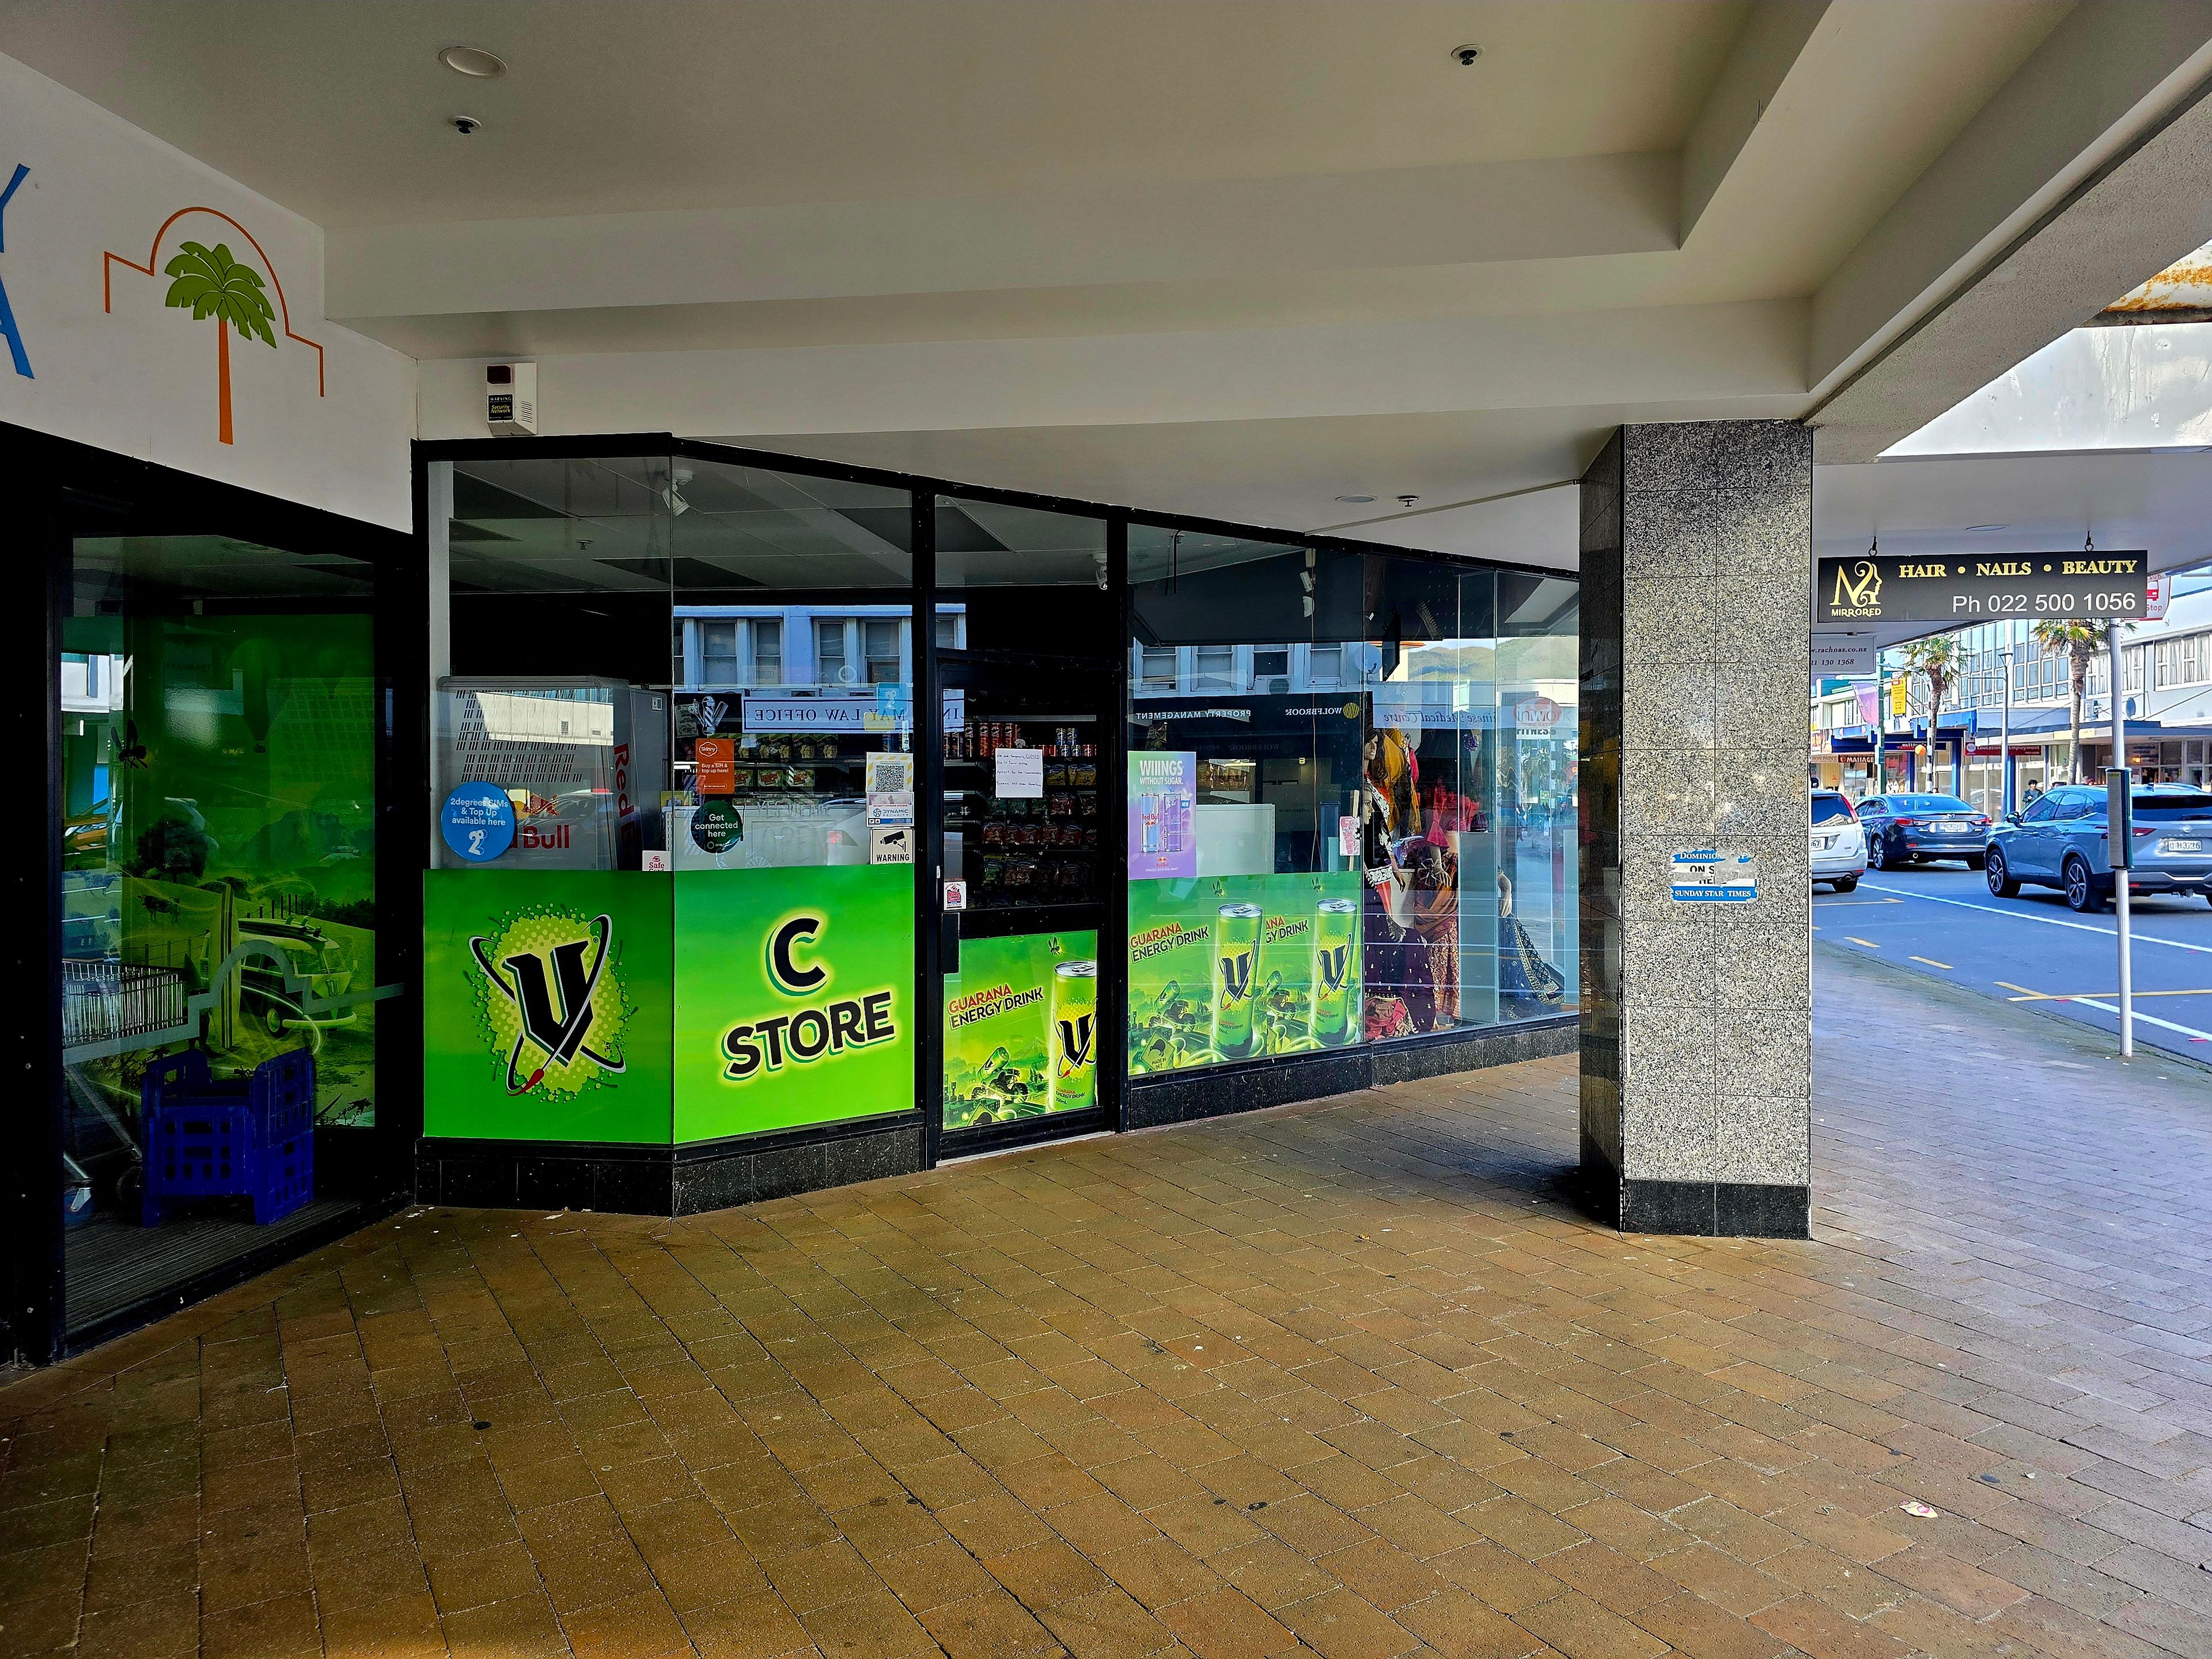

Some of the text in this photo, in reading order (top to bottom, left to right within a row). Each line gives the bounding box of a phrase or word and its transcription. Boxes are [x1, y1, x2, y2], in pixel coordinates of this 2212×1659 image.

[1899, 560, 2138, 578] HAIR NAILS BEAUTY
[1953, 593, 2136, 613] Ph 022 500 1056
[1831, 608, 1883, 618] MIRRORED
[1139, 760, 1183, 776] WIIINGS
[613, 743, 635, 819] Red
[1139, 777, 1164, 785] WITHOUT
[450, 798, 509, 808] 2degrees SIMs
[469, 808, 484, 817] Top
[486, 809, 497, 817] Up
[452, 817, 506, 826] available here
[695, 821, 738, 830] connected
[523, 825, 570, 849] Bull
[876, 853, 910, 862] WARNING
[1130, 922, 1183, 948] GUARANA
[1279, 920, 1309, 939] DRINK
[771, 917, 827, 990] C
[1132, 926, 1209, 962] ENERGY DRINK
[948, 984, 1013, 1014] GUARANA
[950, 987, 1044, 1029] ENERGY DRINK
[724, 991, 896, 1078] STORE
